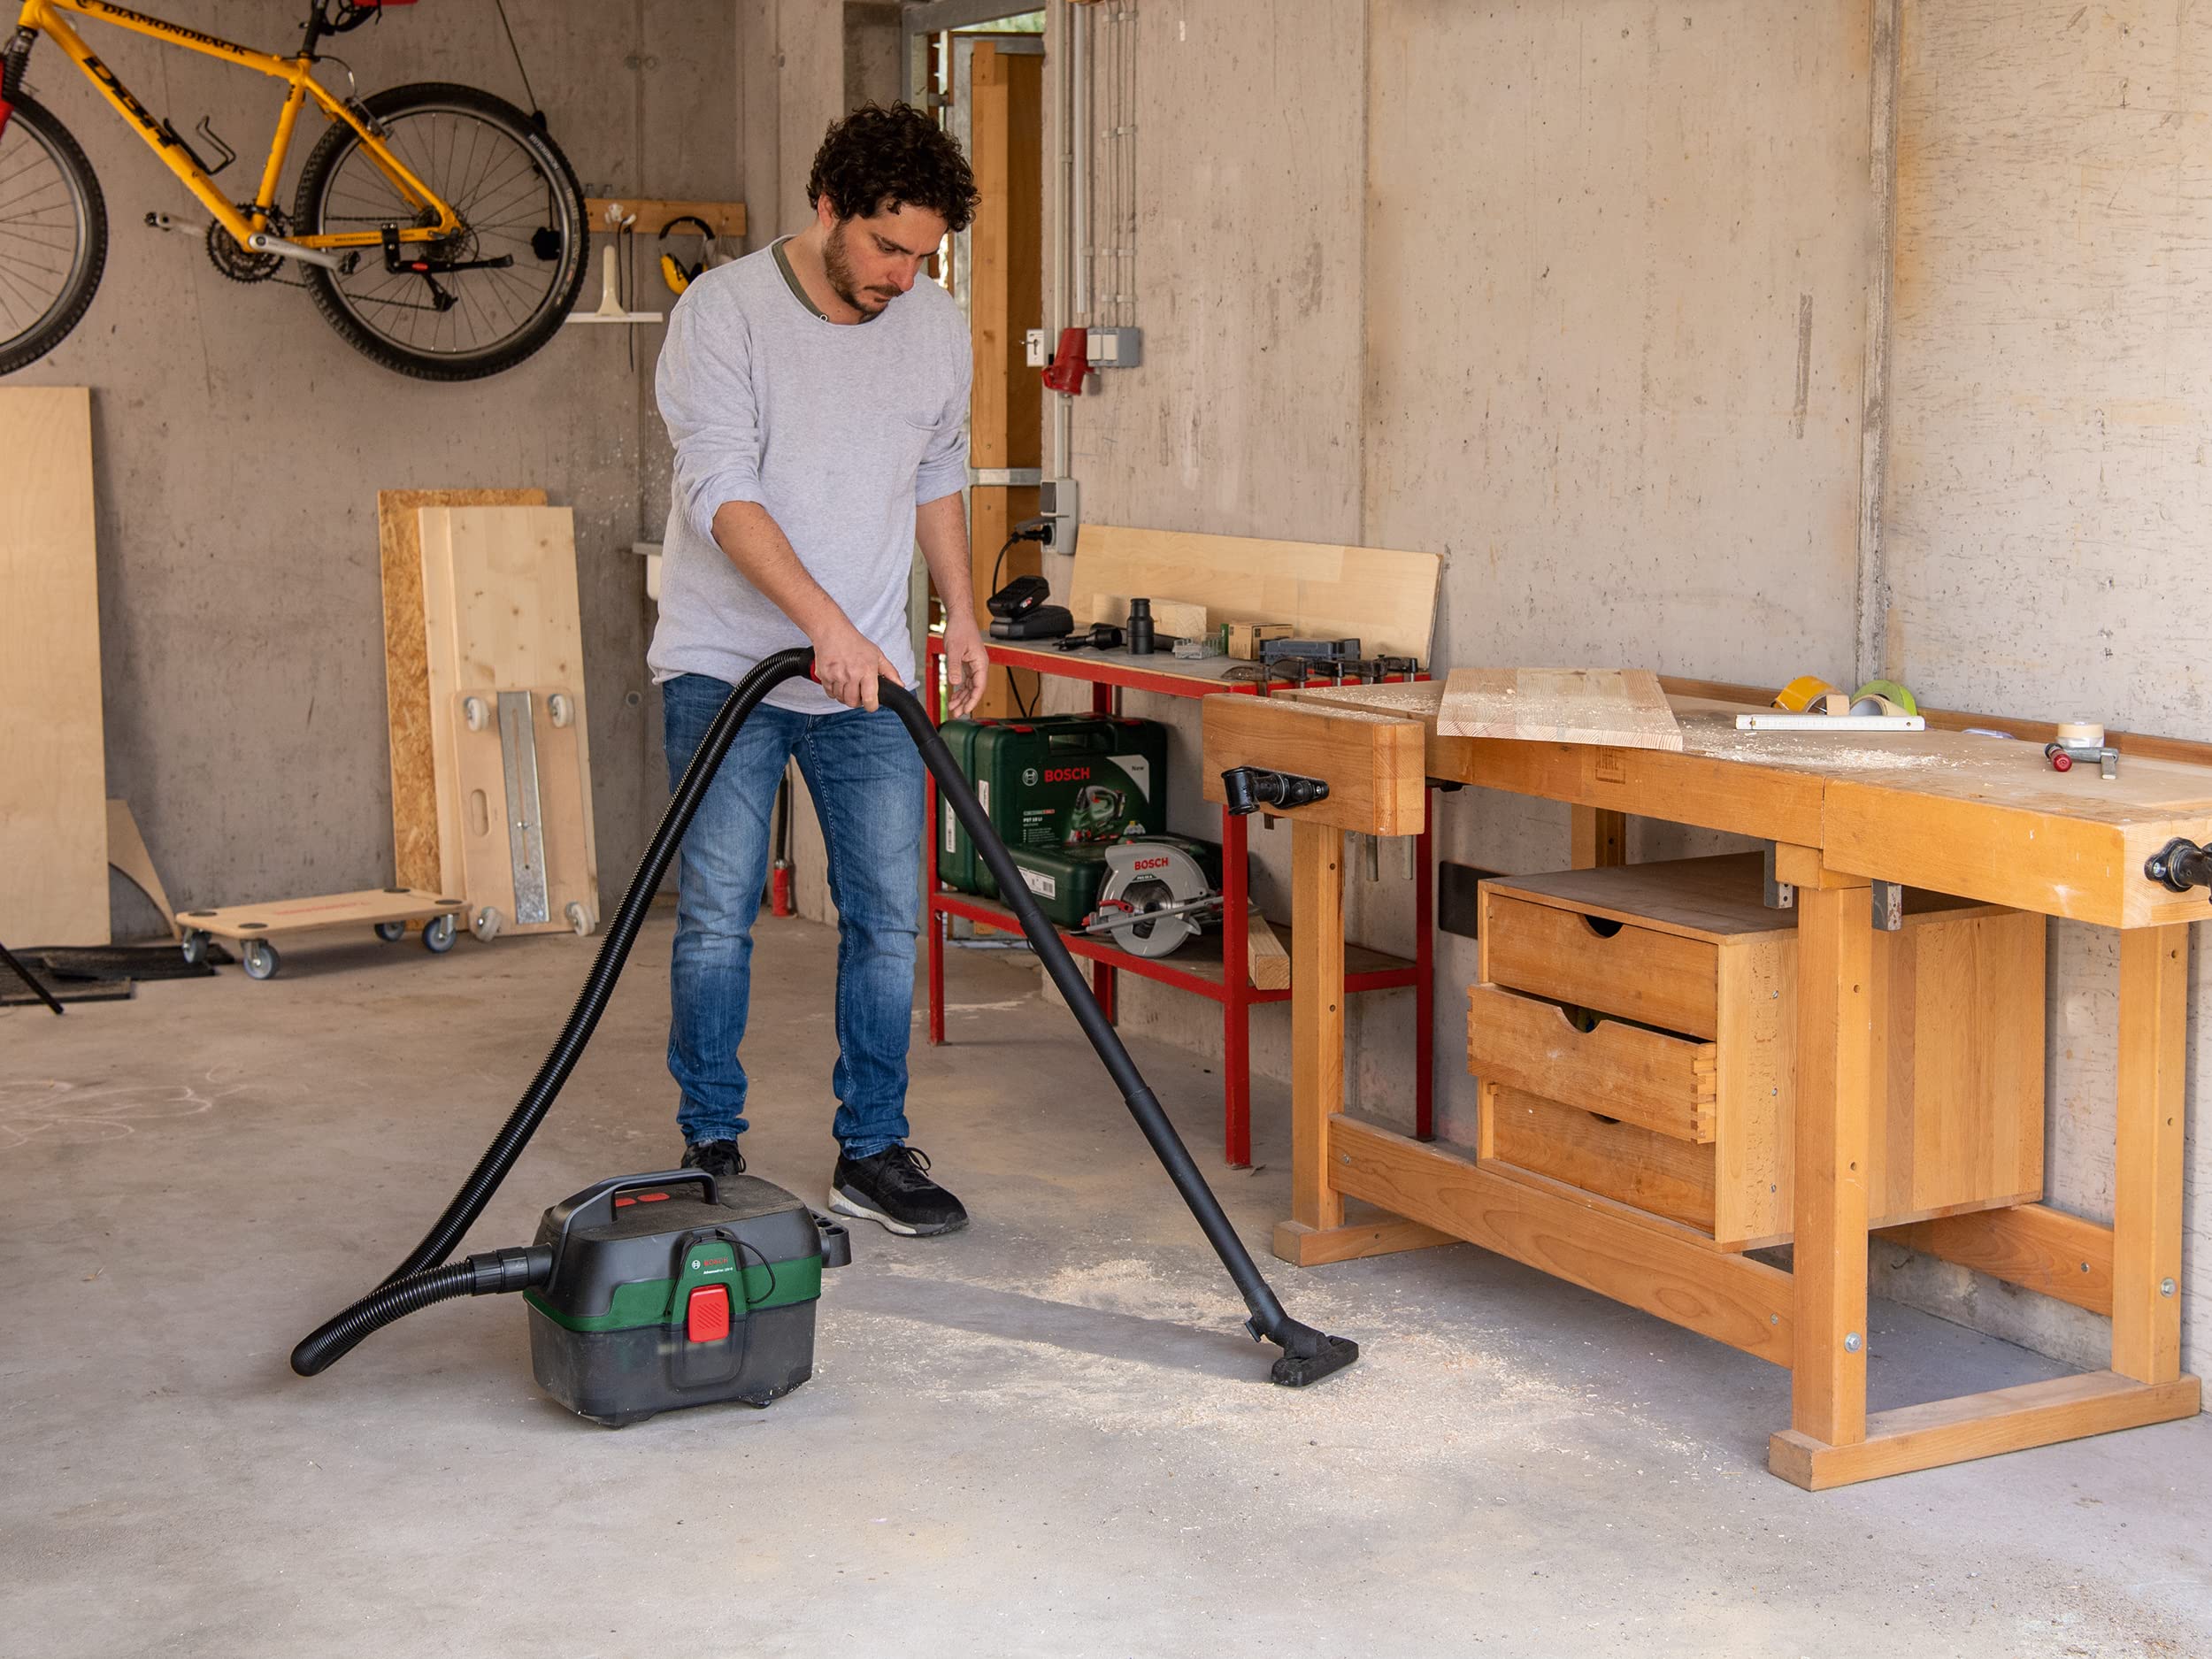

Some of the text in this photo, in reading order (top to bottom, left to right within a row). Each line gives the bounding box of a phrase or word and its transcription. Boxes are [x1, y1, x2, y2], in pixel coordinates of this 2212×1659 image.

[101, 3, 247, 57] DIAMONDBACK
[1044, 767, 1091, 783] BOSCH
[1134, 857, 1169, 871] BOSCH
[703, 1257, 728, 1267] BOSCH
